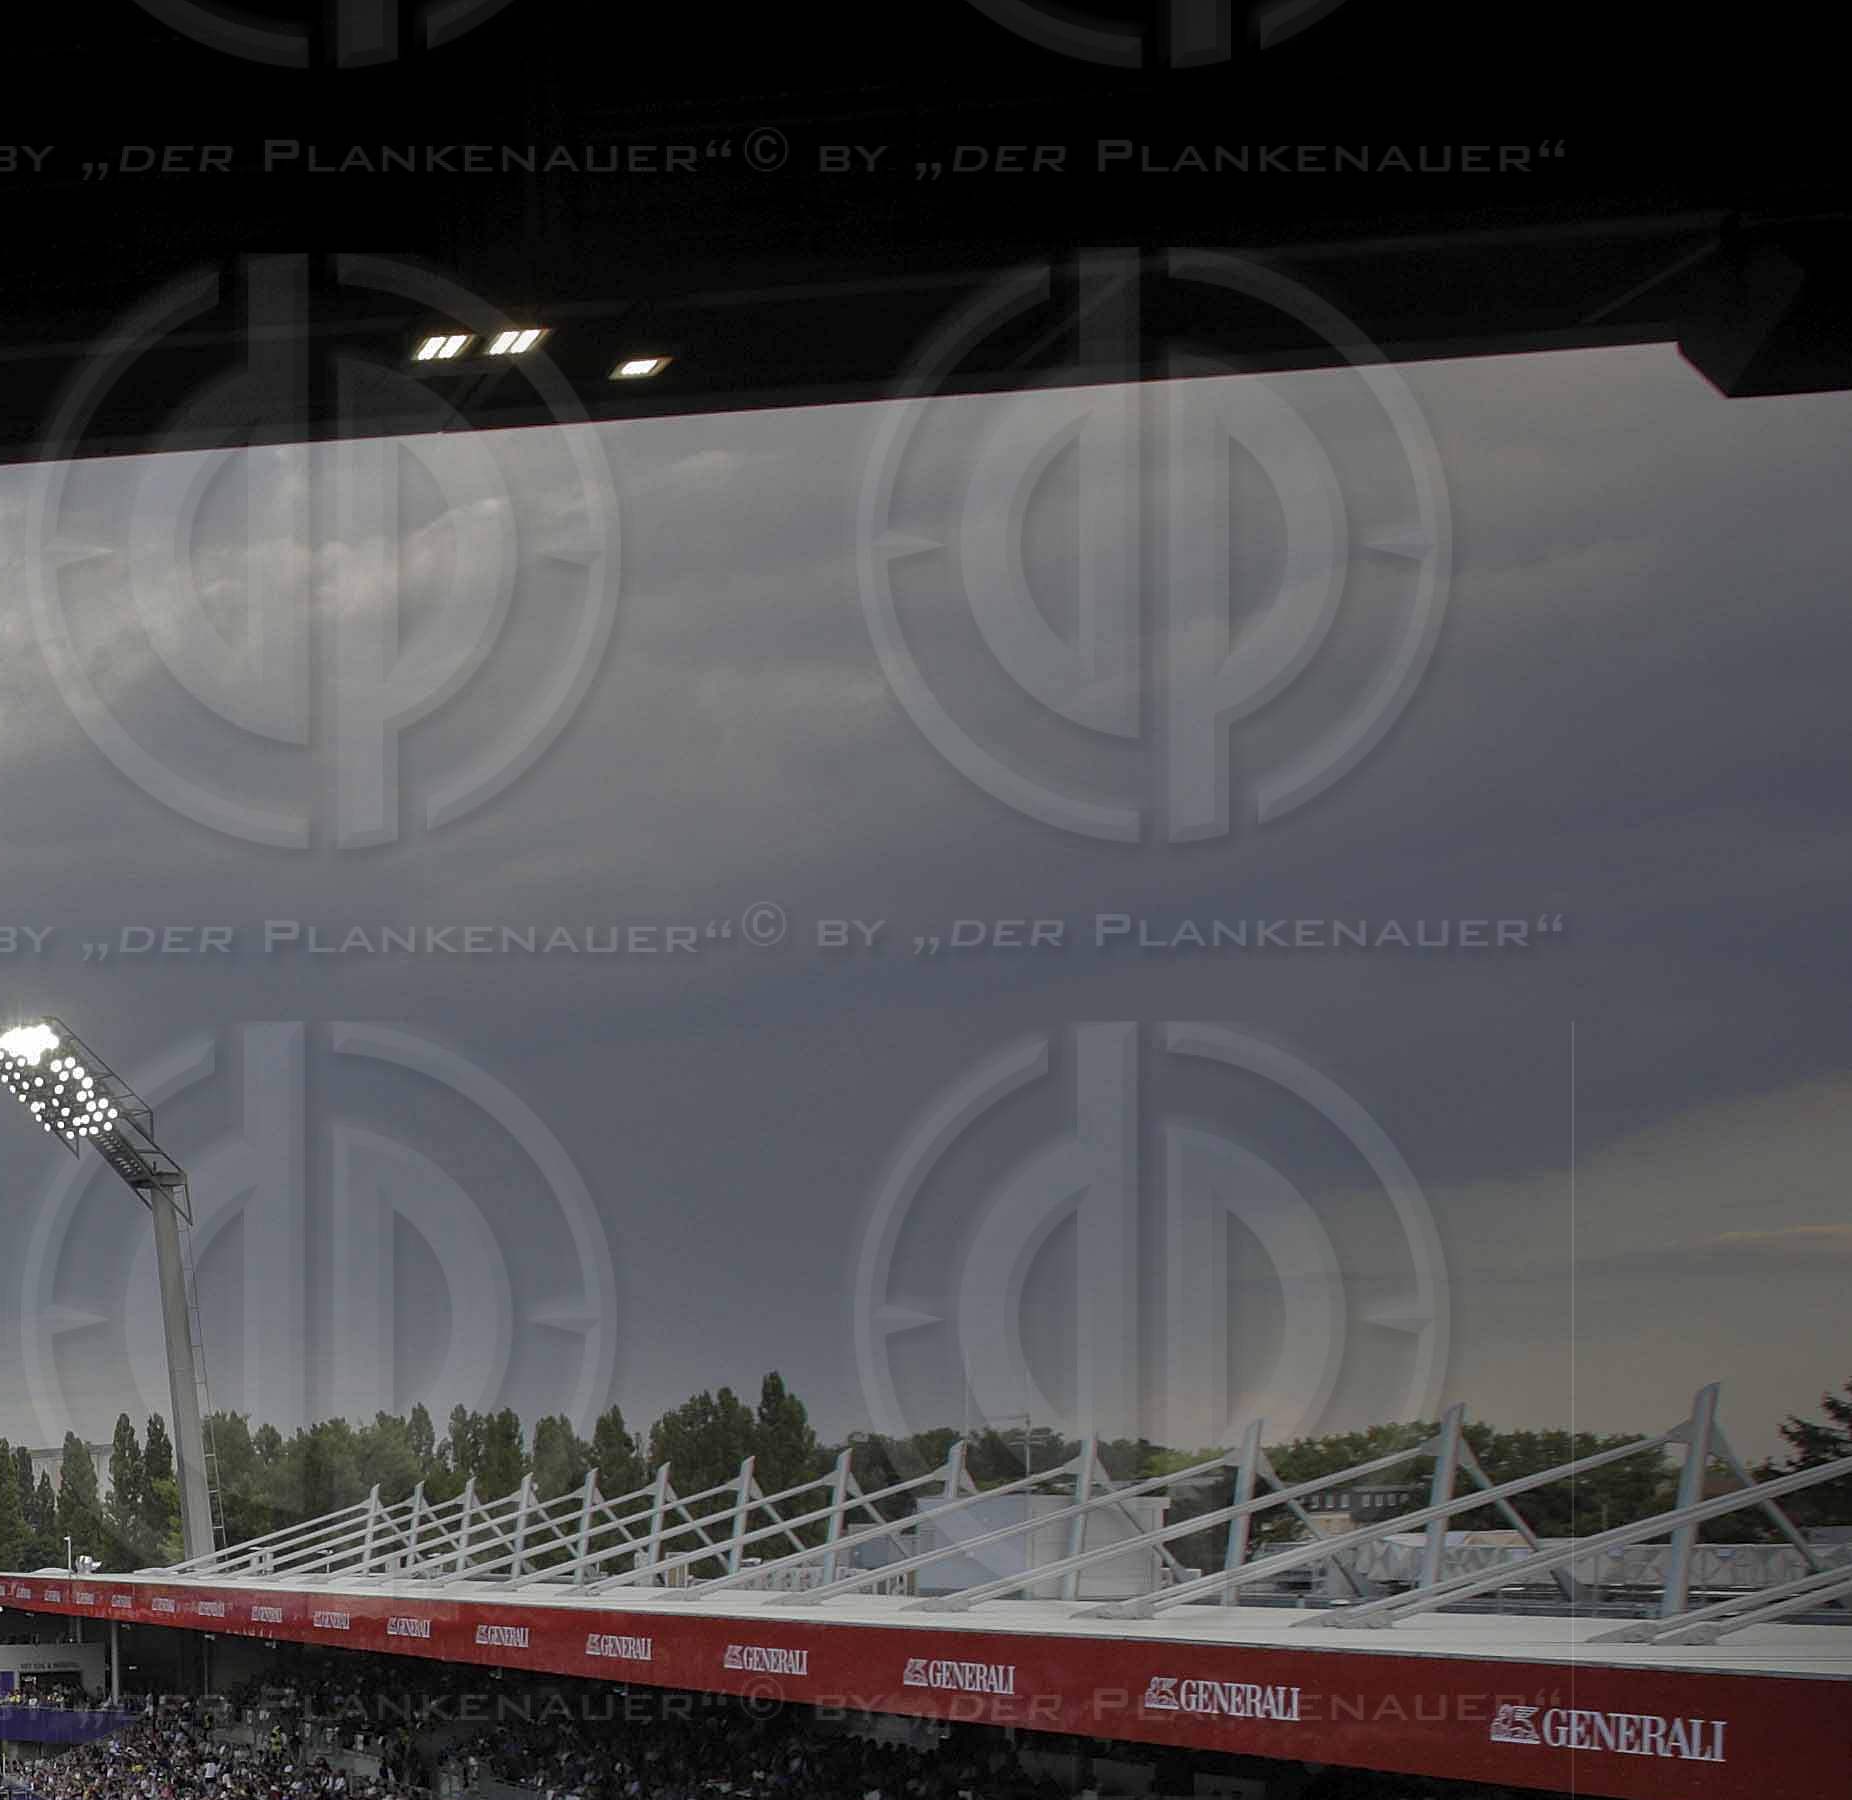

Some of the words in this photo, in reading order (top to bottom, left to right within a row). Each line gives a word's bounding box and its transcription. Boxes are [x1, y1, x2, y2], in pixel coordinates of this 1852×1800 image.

[396, 1617, 432, 1639] GENERALI
[487, 1626, 529, 1648] GENERALI
[601, 1635, 652, 1661] GENERALI
[743, 1645, 808, 1676] GENERALI
[928, 1660, 1015, 1695] GENERALI
[1178, 1677, 1300, 1721] GENERALI
[1541, 1707, 1726, 1763] GENERALI
